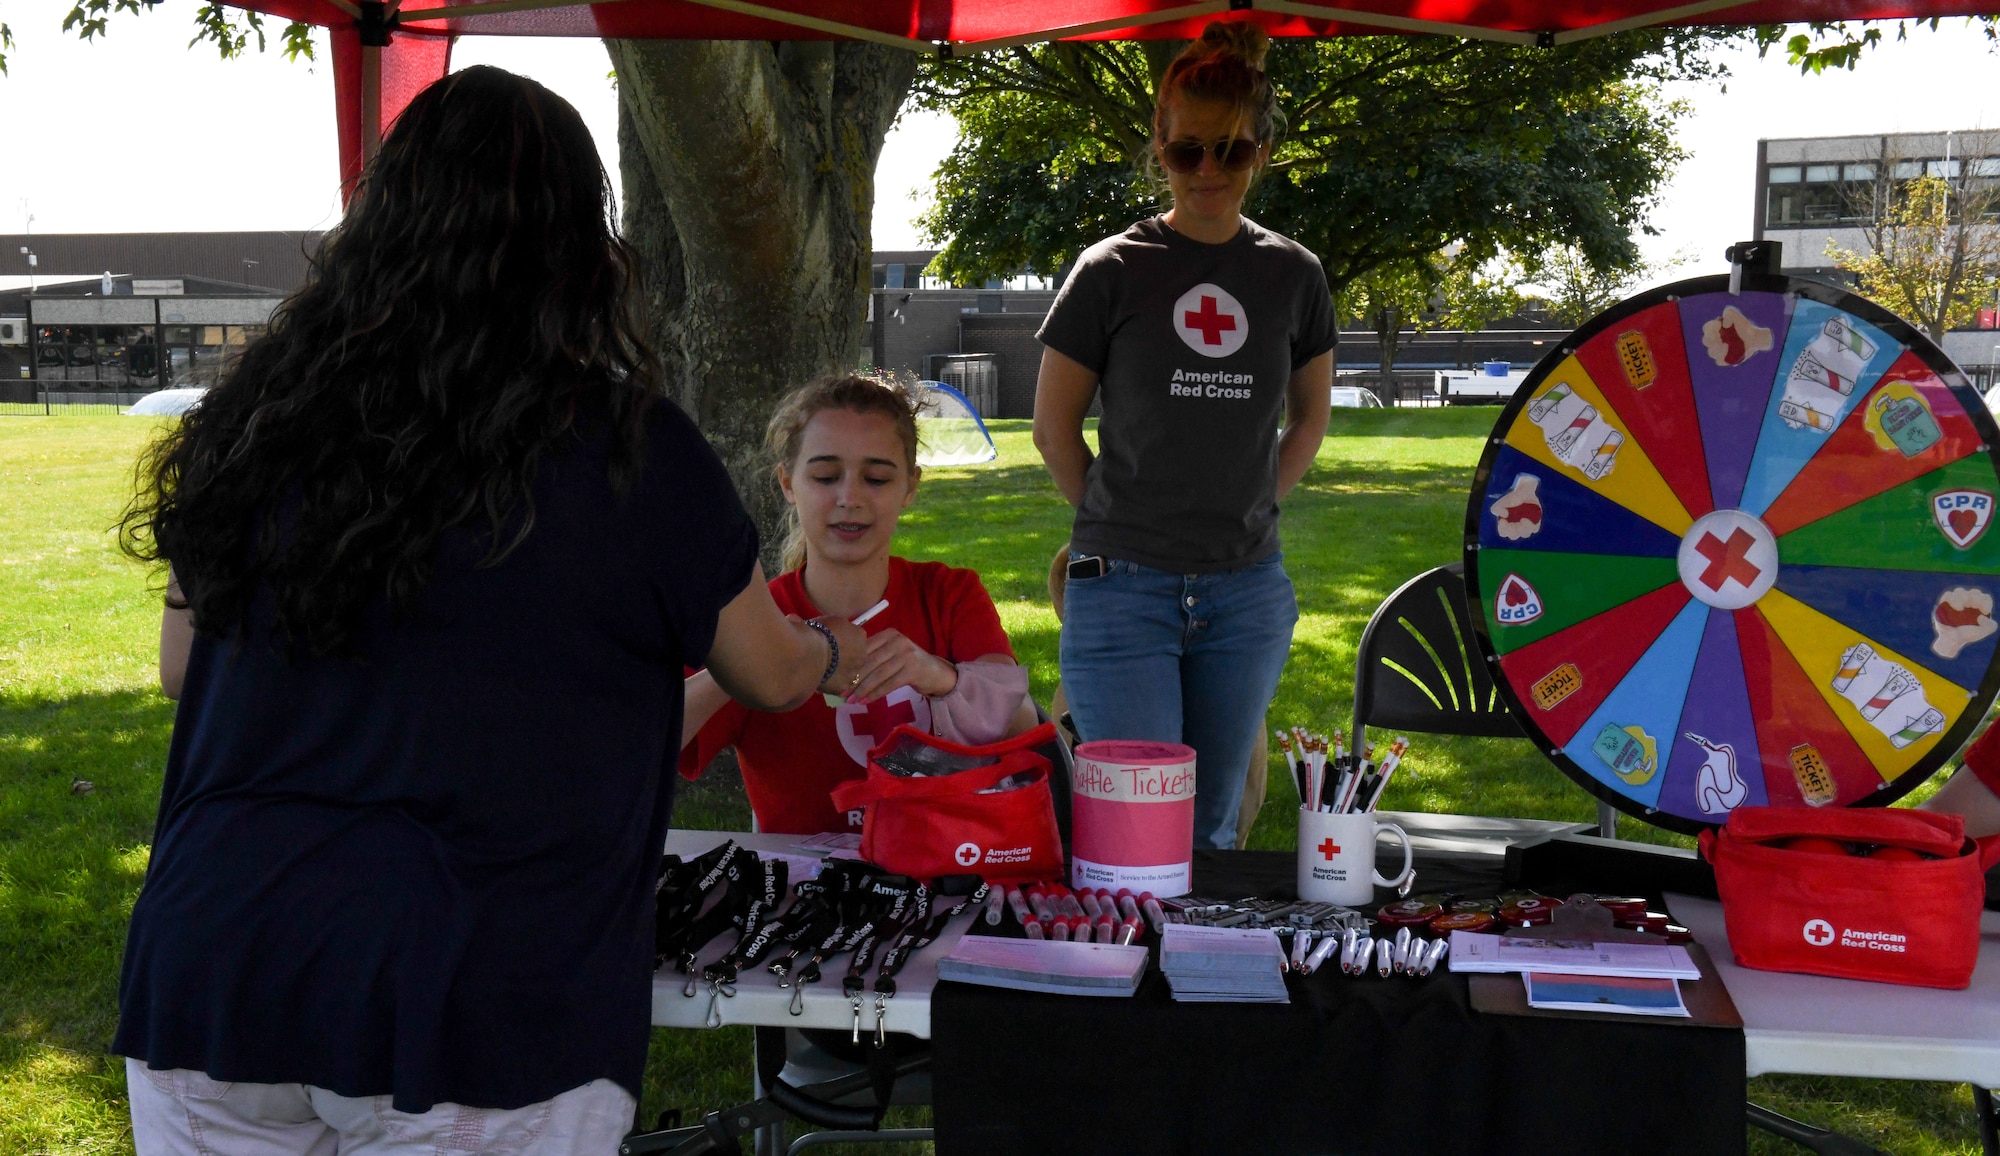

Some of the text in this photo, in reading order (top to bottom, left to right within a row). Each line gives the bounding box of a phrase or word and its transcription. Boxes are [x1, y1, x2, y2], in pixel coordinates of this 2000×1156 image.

[1626, 342, 1646, 379] TICKET
[1171, 368, 1254, 385] American
[1169, 382, 1252, 399] Red Cross
[1938, 495, 1988, 509] CPR
[1500, 603, 1539, 620] CPR
[1541, 673, 1573, 700] TICKET
[1074, 760, 1195, 796] Raffle Tickets
[1801, 754, 1825, 792] TICKET
[984, 855, 1031, 863] Red Cross
[987, 847, 1032, 856] American
[1085, 872, 1114, 883] Red Cross
[1086, 867, 1114, 876] American
[1312, 872, 1325, 880] Red
[1313, 866, 1347, 875] American
[765, 875, 776, 893] Red
[1842, 928, 1906, 943] American
[746, 935, 767, 958] Cross
[1841, 937, 1906, 952] Red Cross
